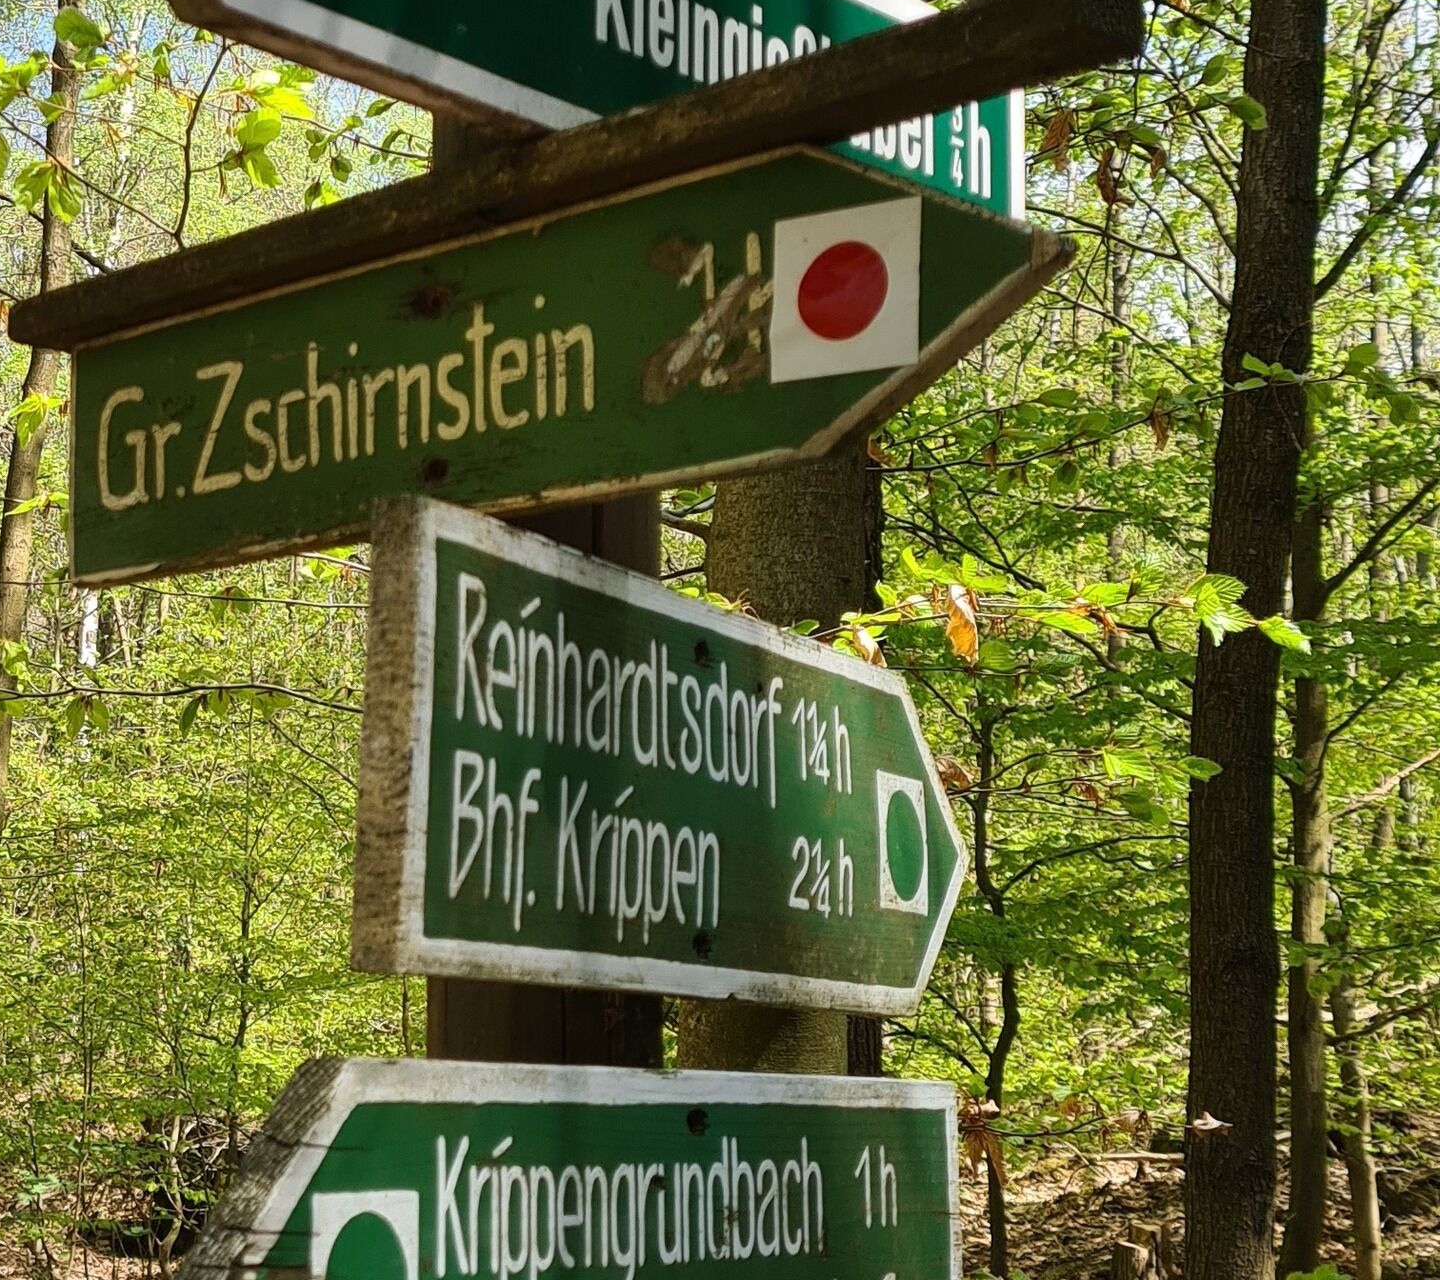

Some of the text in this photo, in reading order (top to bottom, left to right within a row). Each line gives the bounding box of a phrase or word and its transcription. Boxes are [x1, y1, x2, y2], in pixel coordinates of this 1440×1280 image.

[456, 571, 784, 810] Reinhardtsdorf
[448, 748, 542, 933] Bhf.
[555, 774, 722, 945] Krippen
